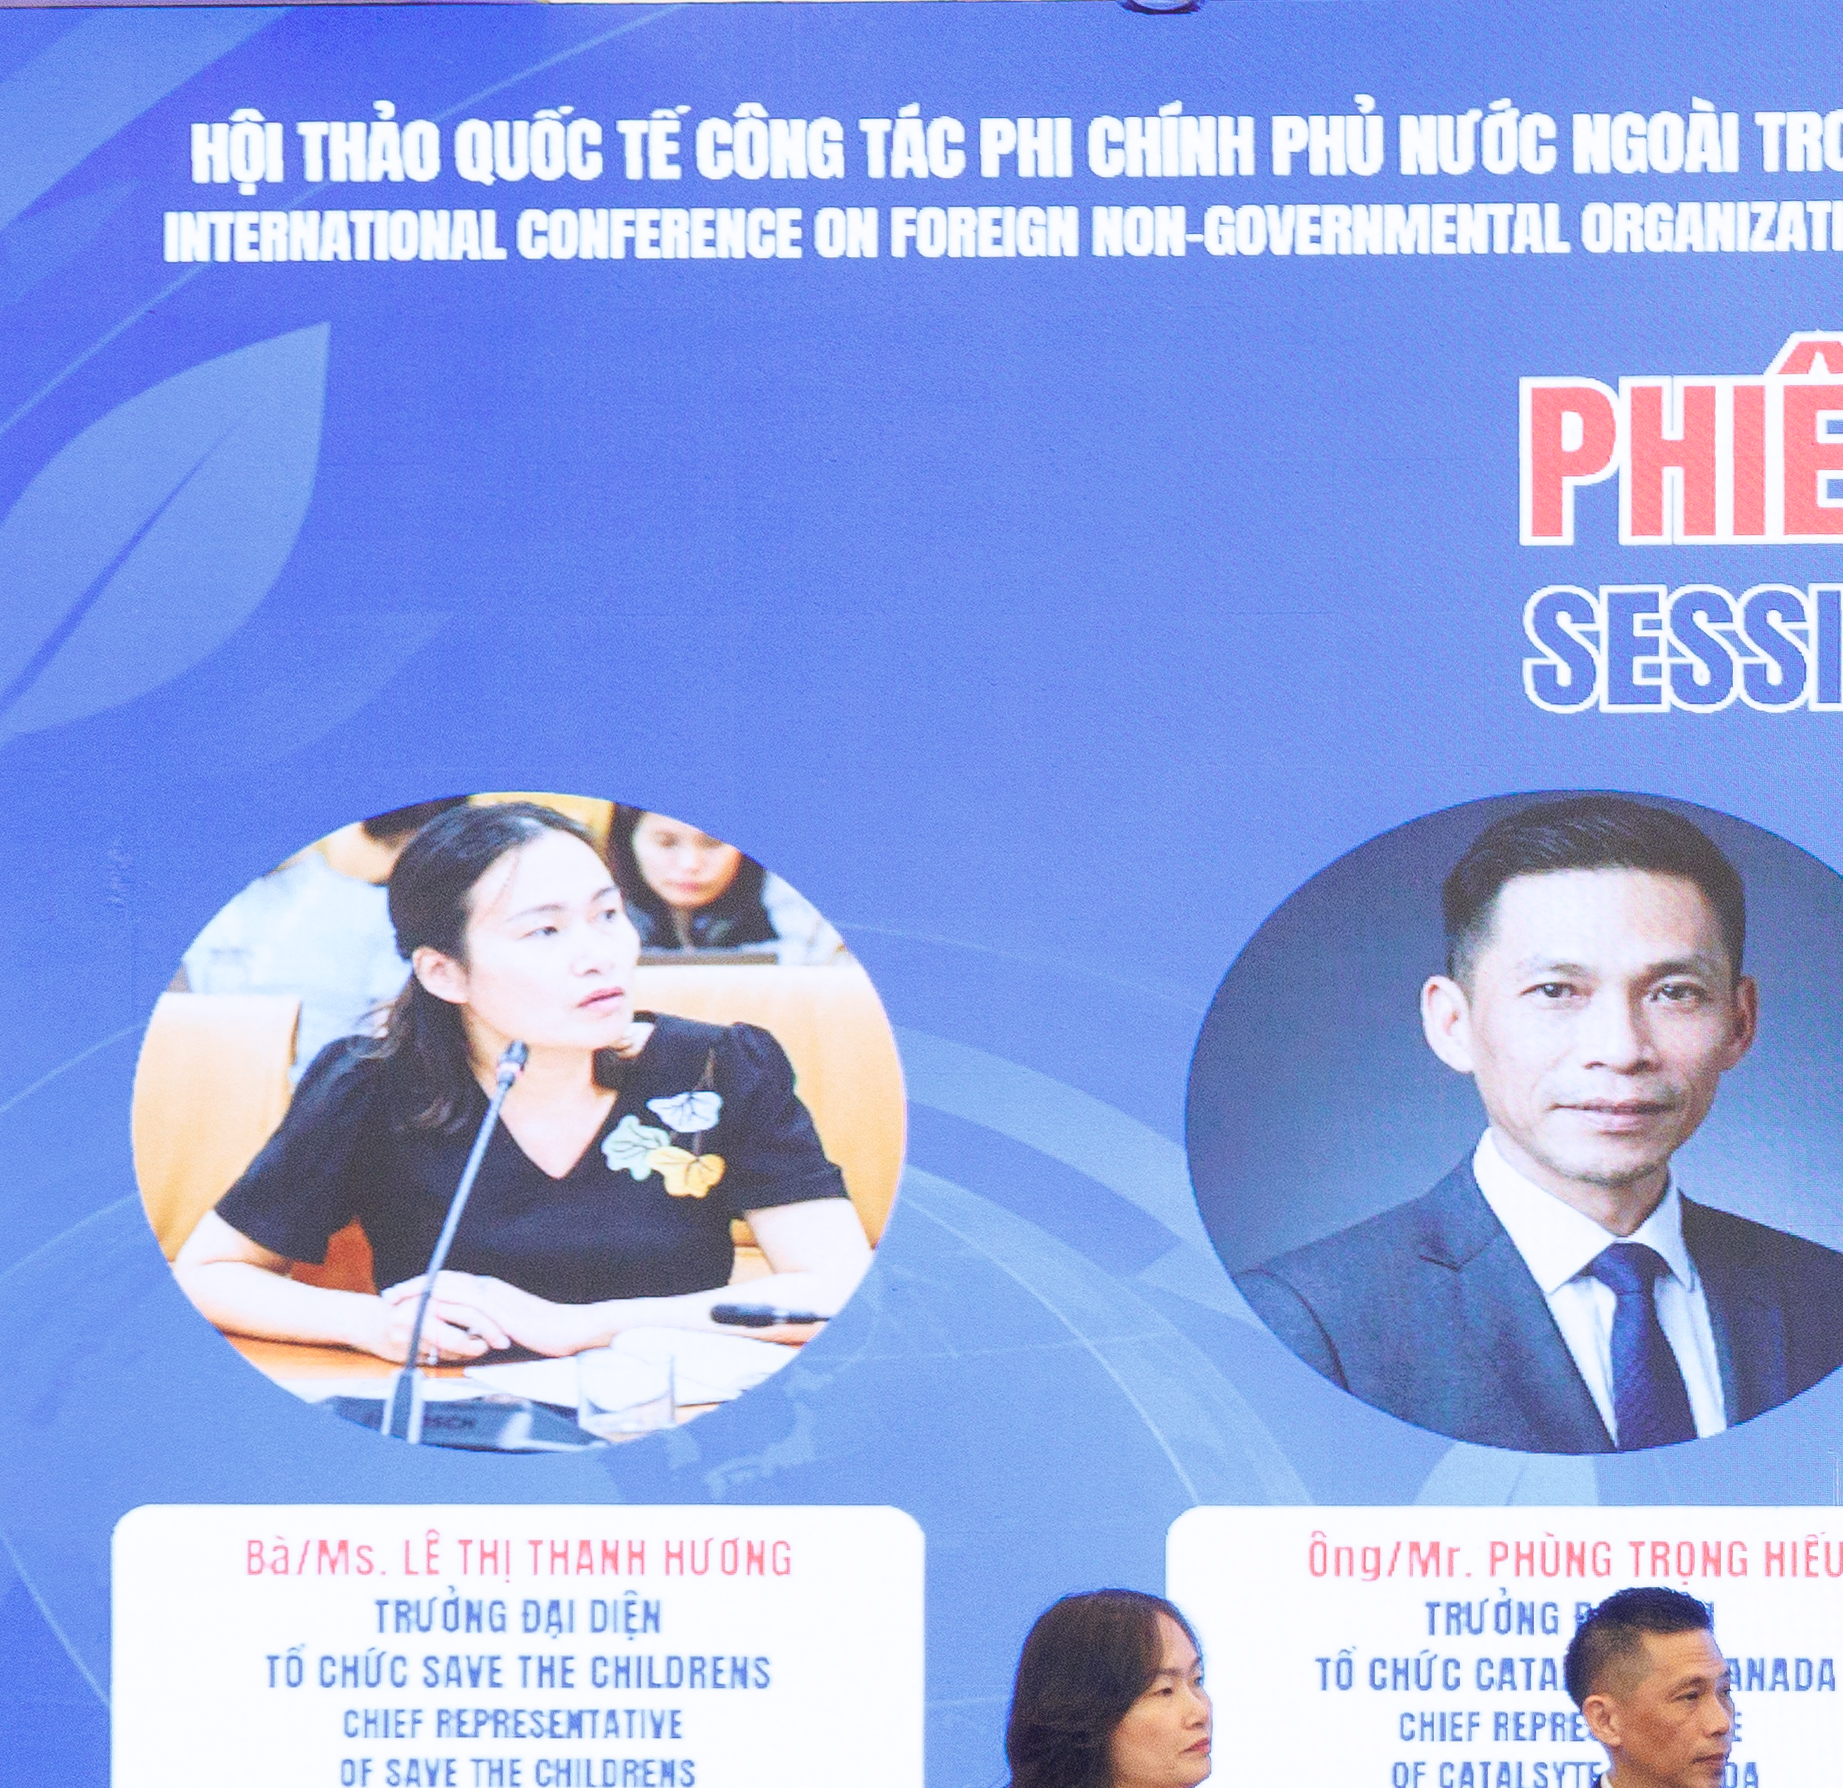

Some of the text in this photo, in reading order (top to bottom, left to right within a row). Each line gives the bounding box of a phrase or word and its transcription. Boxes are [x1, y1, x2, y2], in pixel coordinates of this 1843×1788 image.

[192, 108, 284, 196] HỘI
[298, 100, 440, 182] THẢO
[455, 106, 603, 185] QUỐC
[618, 105, 688, 180] TẾ
[696, 102, 845, 180] CÔNG
[859, 104, 966, 179] TÁC
[980, 117, 1073, 178] PHI
[1088, 102, 1255, 178] CHÍNH
[1272, 94, 1384, 177] PHỦ
[1400, 98, 1557, 176] NƯỚC
[1572, 98, 1739, 174] NGOÀI
[165, 209, 507, 262] INTERNATIONAL
[518, 208, 802, 260] CONFERENCE
[815, 207, 878, 259] ON
[891, 206, 1079, 258] FOREIGN
[1093, 203, 1571, 257] NON-GOVERNMENTAL
[403, 1528, 792, 1585] LÊ THỊ THANH HƯƠNG
[1308, 1529, 1472, 1582] Ông/Mr.
[1489, 1531, 1612, 1579] PHÙNG
[1627, 1540, 1749, 1586] TRỌNG
[373, 1583, 662, 1643] TRƯỞNG ĐẠI DIỆN
[1423, 1585, 1561, 1637] TRƯỞNG
[264, 1644, 773, 1691] TỔ CHỨC SAVE THE CHILDRENS
[1314, 1645, 1462, 1693] TỔ CHỨC
[342, 1707, 684, 1741] CHIEF REPRESENTATIVE
[1398, 1710, 1482, 1743] CHIEF
[339, 1756, 374, 1788] OF
[384, 1756, 458, 1788] SAVE
